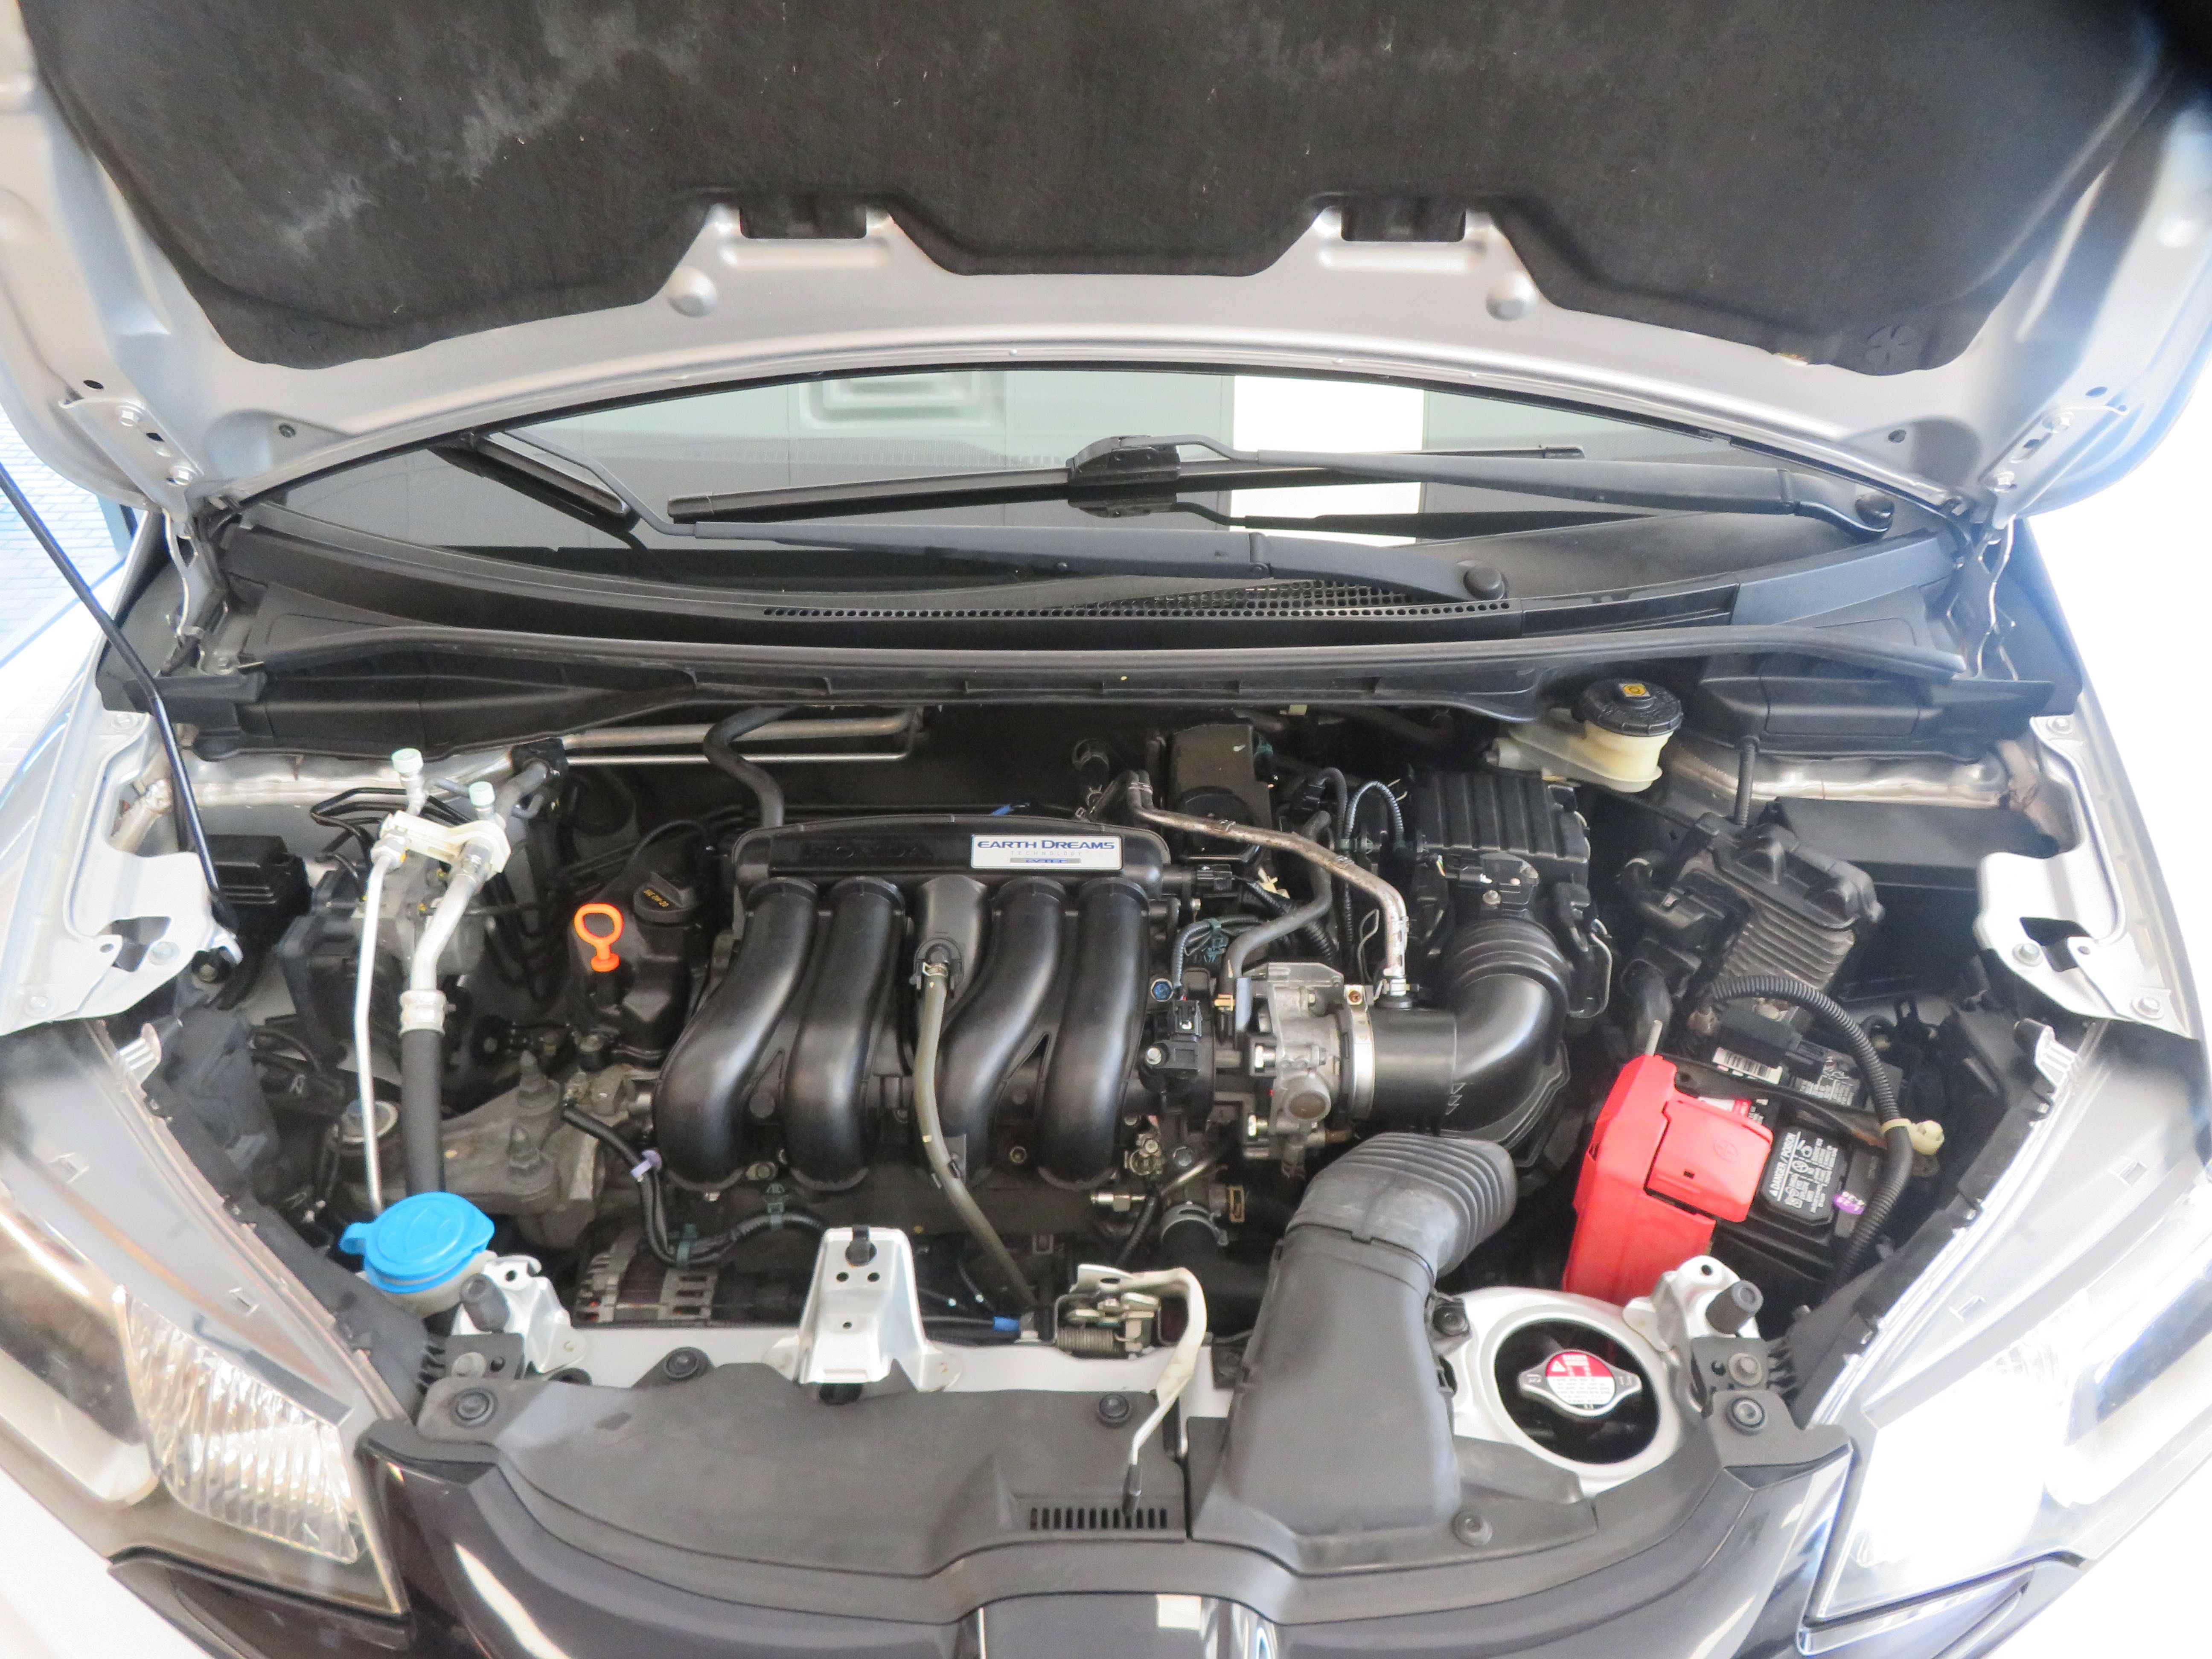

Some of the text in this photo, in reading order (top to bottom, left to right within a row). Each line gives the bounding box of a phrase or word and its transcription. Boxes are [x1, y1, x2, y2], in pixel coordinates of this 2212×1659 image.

[978, 840, 1115, 850] EARTH DREAMS
[1770, 1161, 1787, 1190] DANGER
